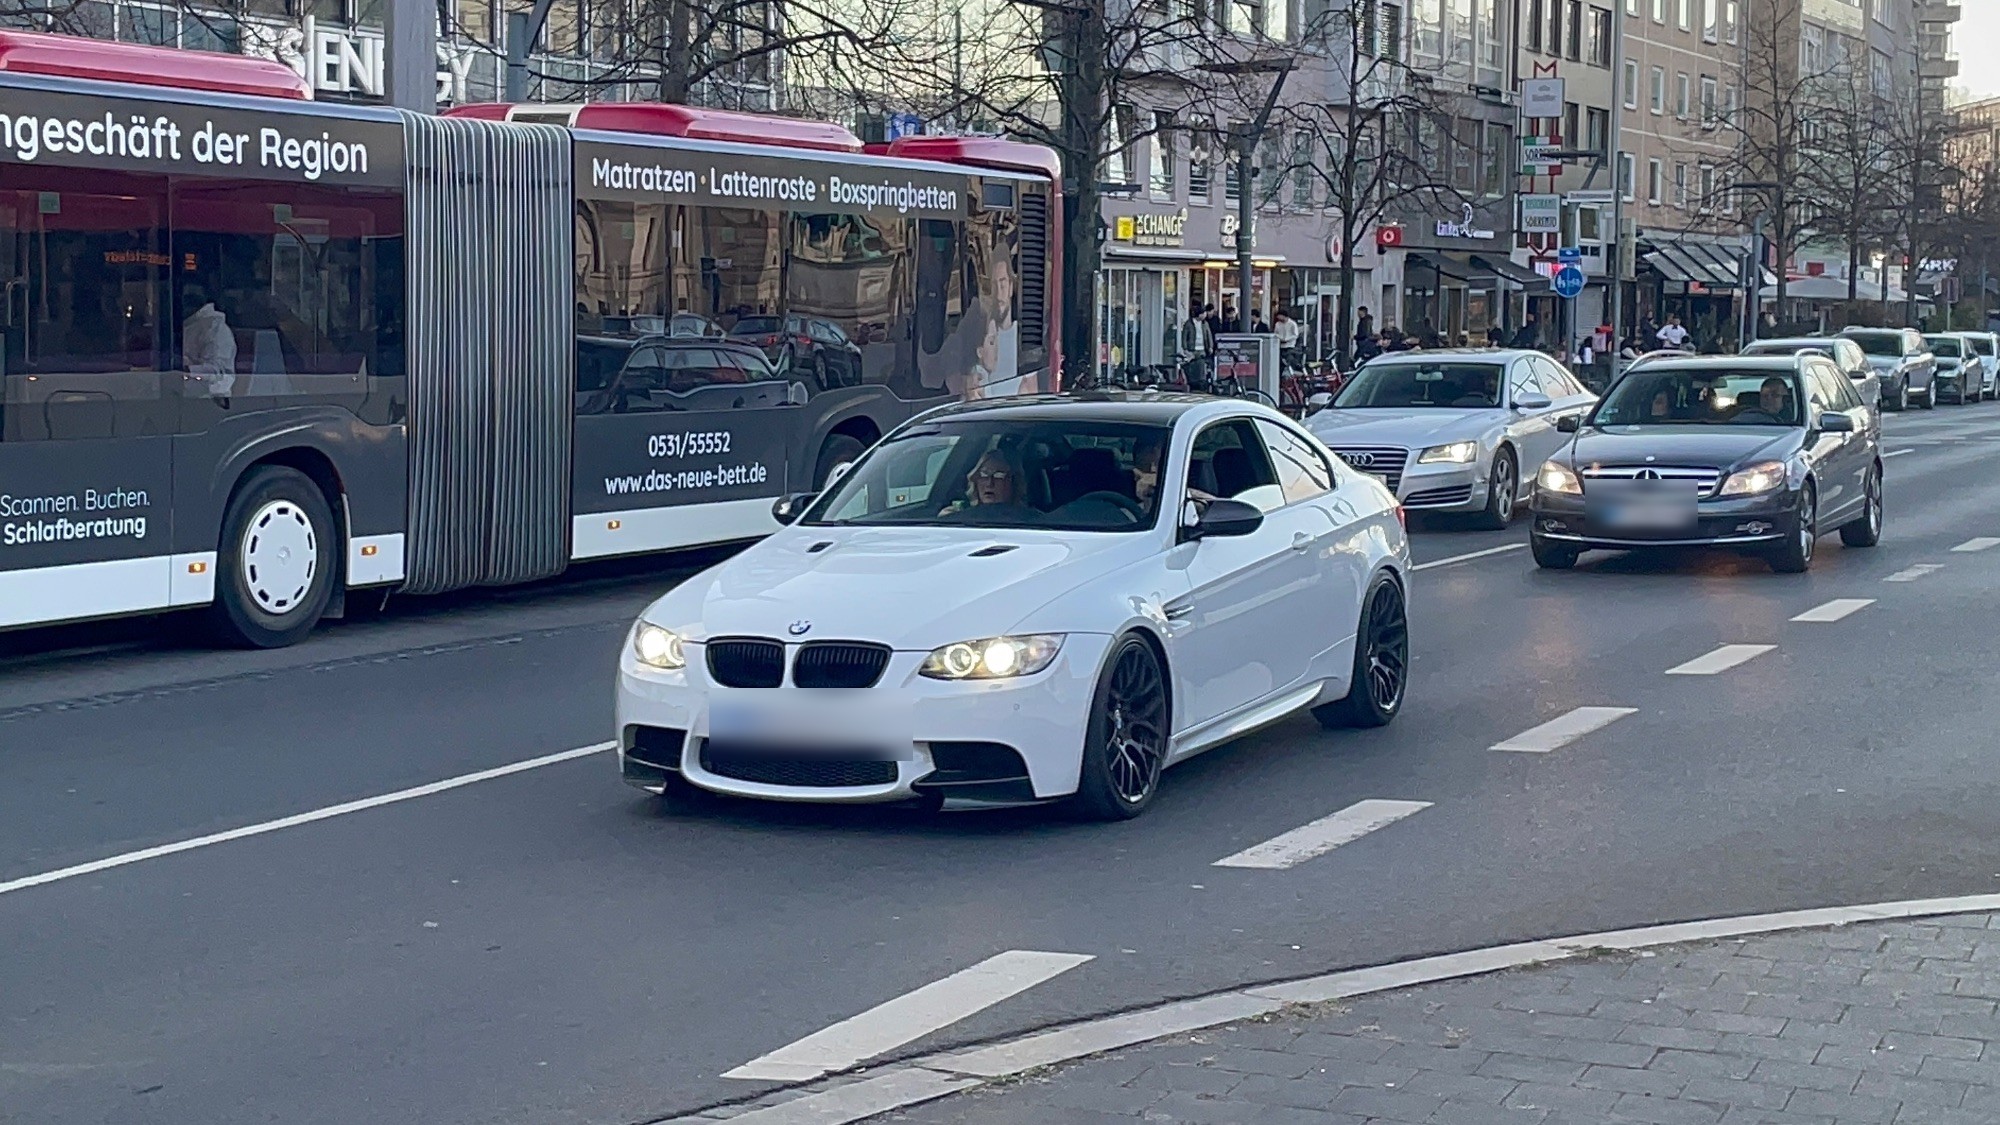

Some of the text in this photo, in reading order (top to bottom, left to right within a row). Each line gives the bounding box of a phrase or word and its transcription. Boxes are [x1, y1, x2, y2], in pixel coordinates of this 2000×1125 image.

[192, 121, 249, 165] der
[260, 128, 368, 180] Region
[592, 157, 957, 213] Matratzen Lattenroste Boxspringbetten
[649, 431, 731, 458] 0531/55552
[605, 462, 766, 494] www.das-neue-bett.de
[0, 487, 150, 516] Scannen. Buchen.
[4, 517, 146, 544] Schlafberatung
